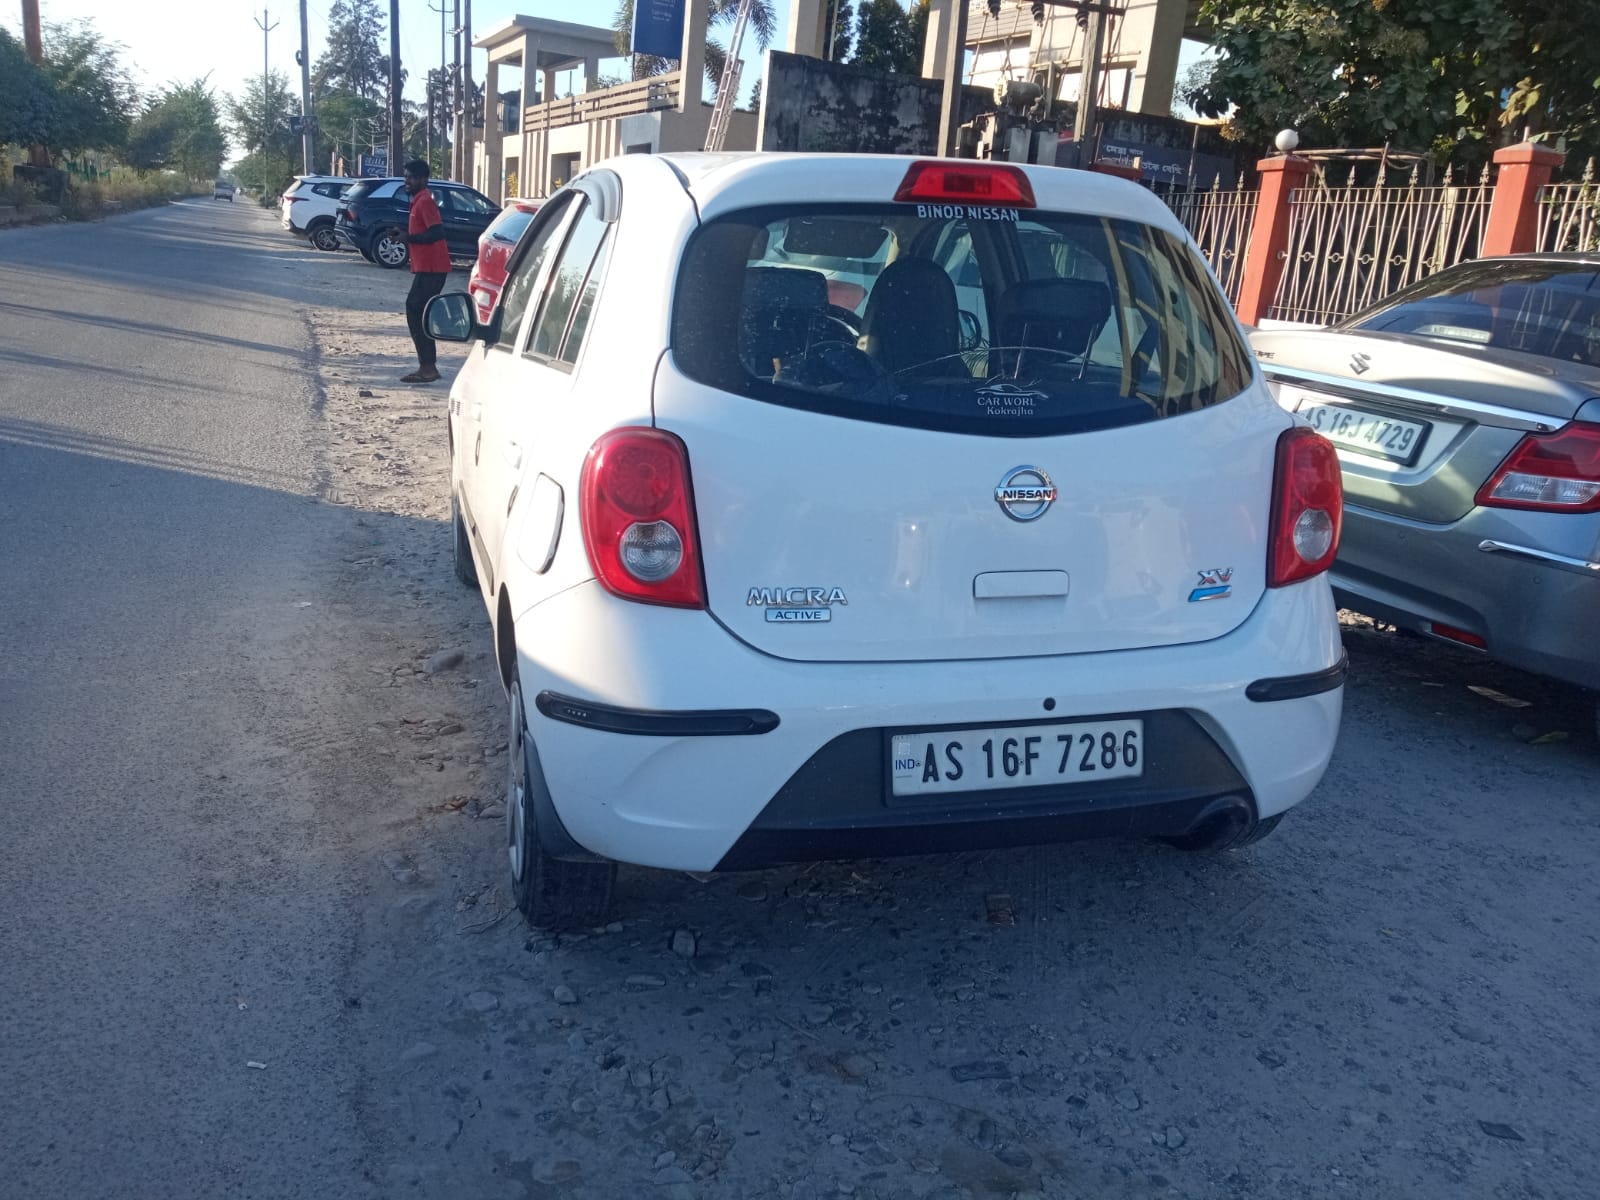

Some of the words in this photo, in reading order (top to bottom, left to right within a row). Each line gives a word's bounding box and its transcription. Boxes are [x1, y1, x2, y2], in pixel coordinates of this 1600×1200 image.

[917, 205, 964, 219] BINOD
[967, 207, 1019, 221] NISSAN
[977, 397, 1000, 406] CAR
[1329, 413, 1364, 438] 16J
[1363, 421, 1415, 451] 4729
[1003, 489, 1051, 499] NISSAN
[1197, 568, 1233, 585] XV
[746, 587, 848, 606] MICRA
[775, 611, 821, 620] ACTIVE
[895, 758, 915, 770] IND
[922, 741, 963, 783] AS
[982, 736, 1042, 778] 16F
[1056, 730, 1138, 774] 7286
